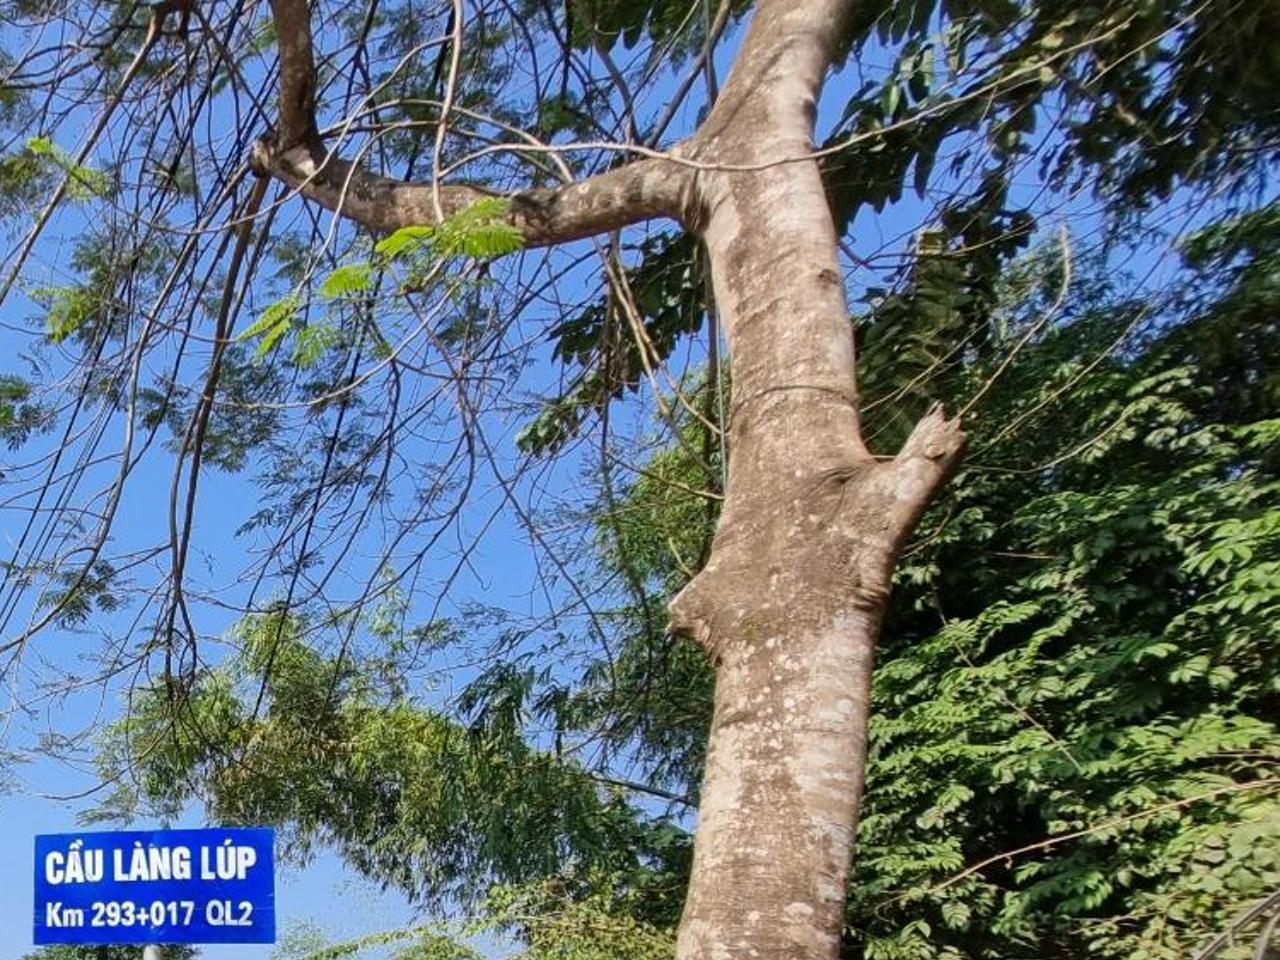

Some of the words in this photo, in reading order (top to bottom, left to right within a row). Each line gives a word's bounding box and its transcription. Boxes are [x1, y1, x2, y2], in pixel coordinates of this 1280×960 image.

[113, 841, 192, 882] LÀNG
[201, 839, 257, 880] LÚP
[46, 902, 84, 927] Km
[91, 901, 195, 926] 293+017
[205, 899, 253, 926] QL2
